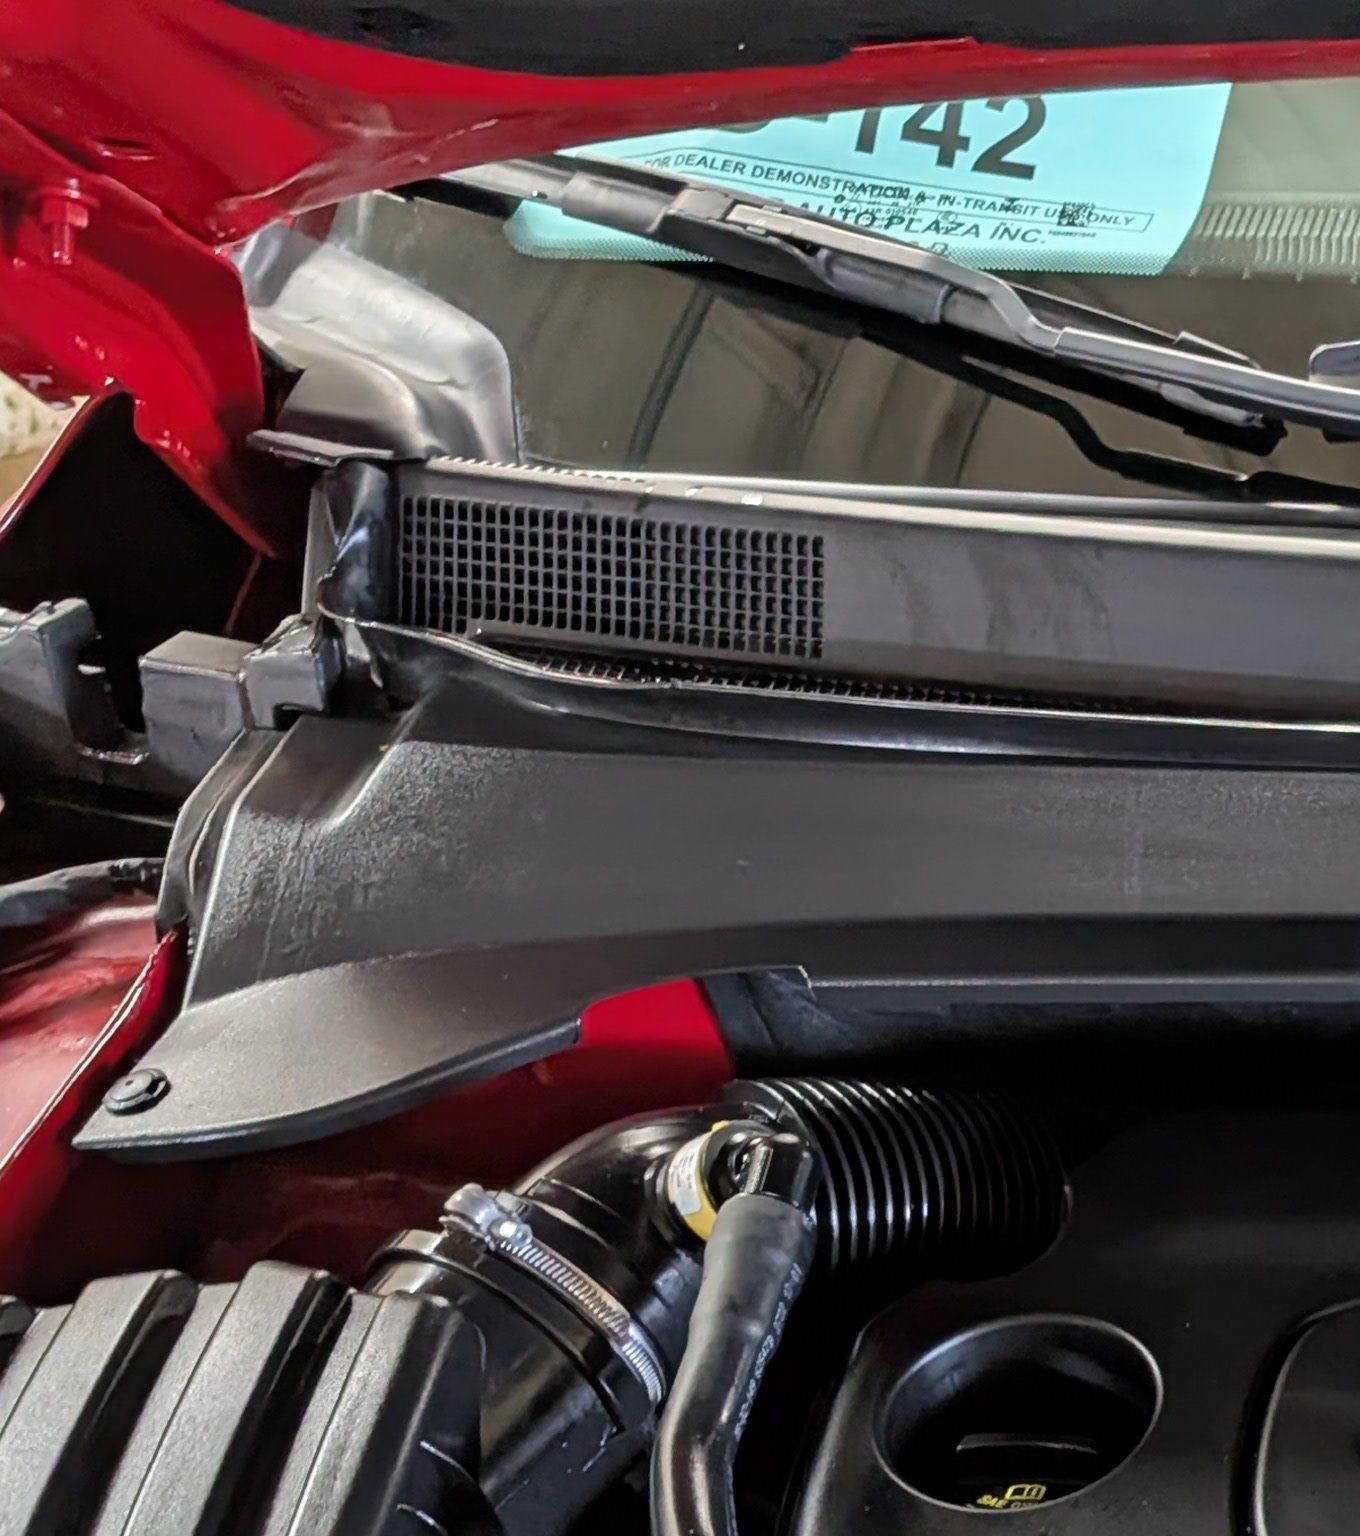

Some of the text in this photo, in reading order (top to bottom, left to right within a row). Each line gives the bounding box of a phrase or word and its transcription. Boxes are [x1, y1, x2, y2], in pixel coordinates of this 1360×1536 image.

[673, 153, 746, 176] DEALER
[884, 215, 980, 238] PLAZA
[989, 224, 1046, 244] INC.
